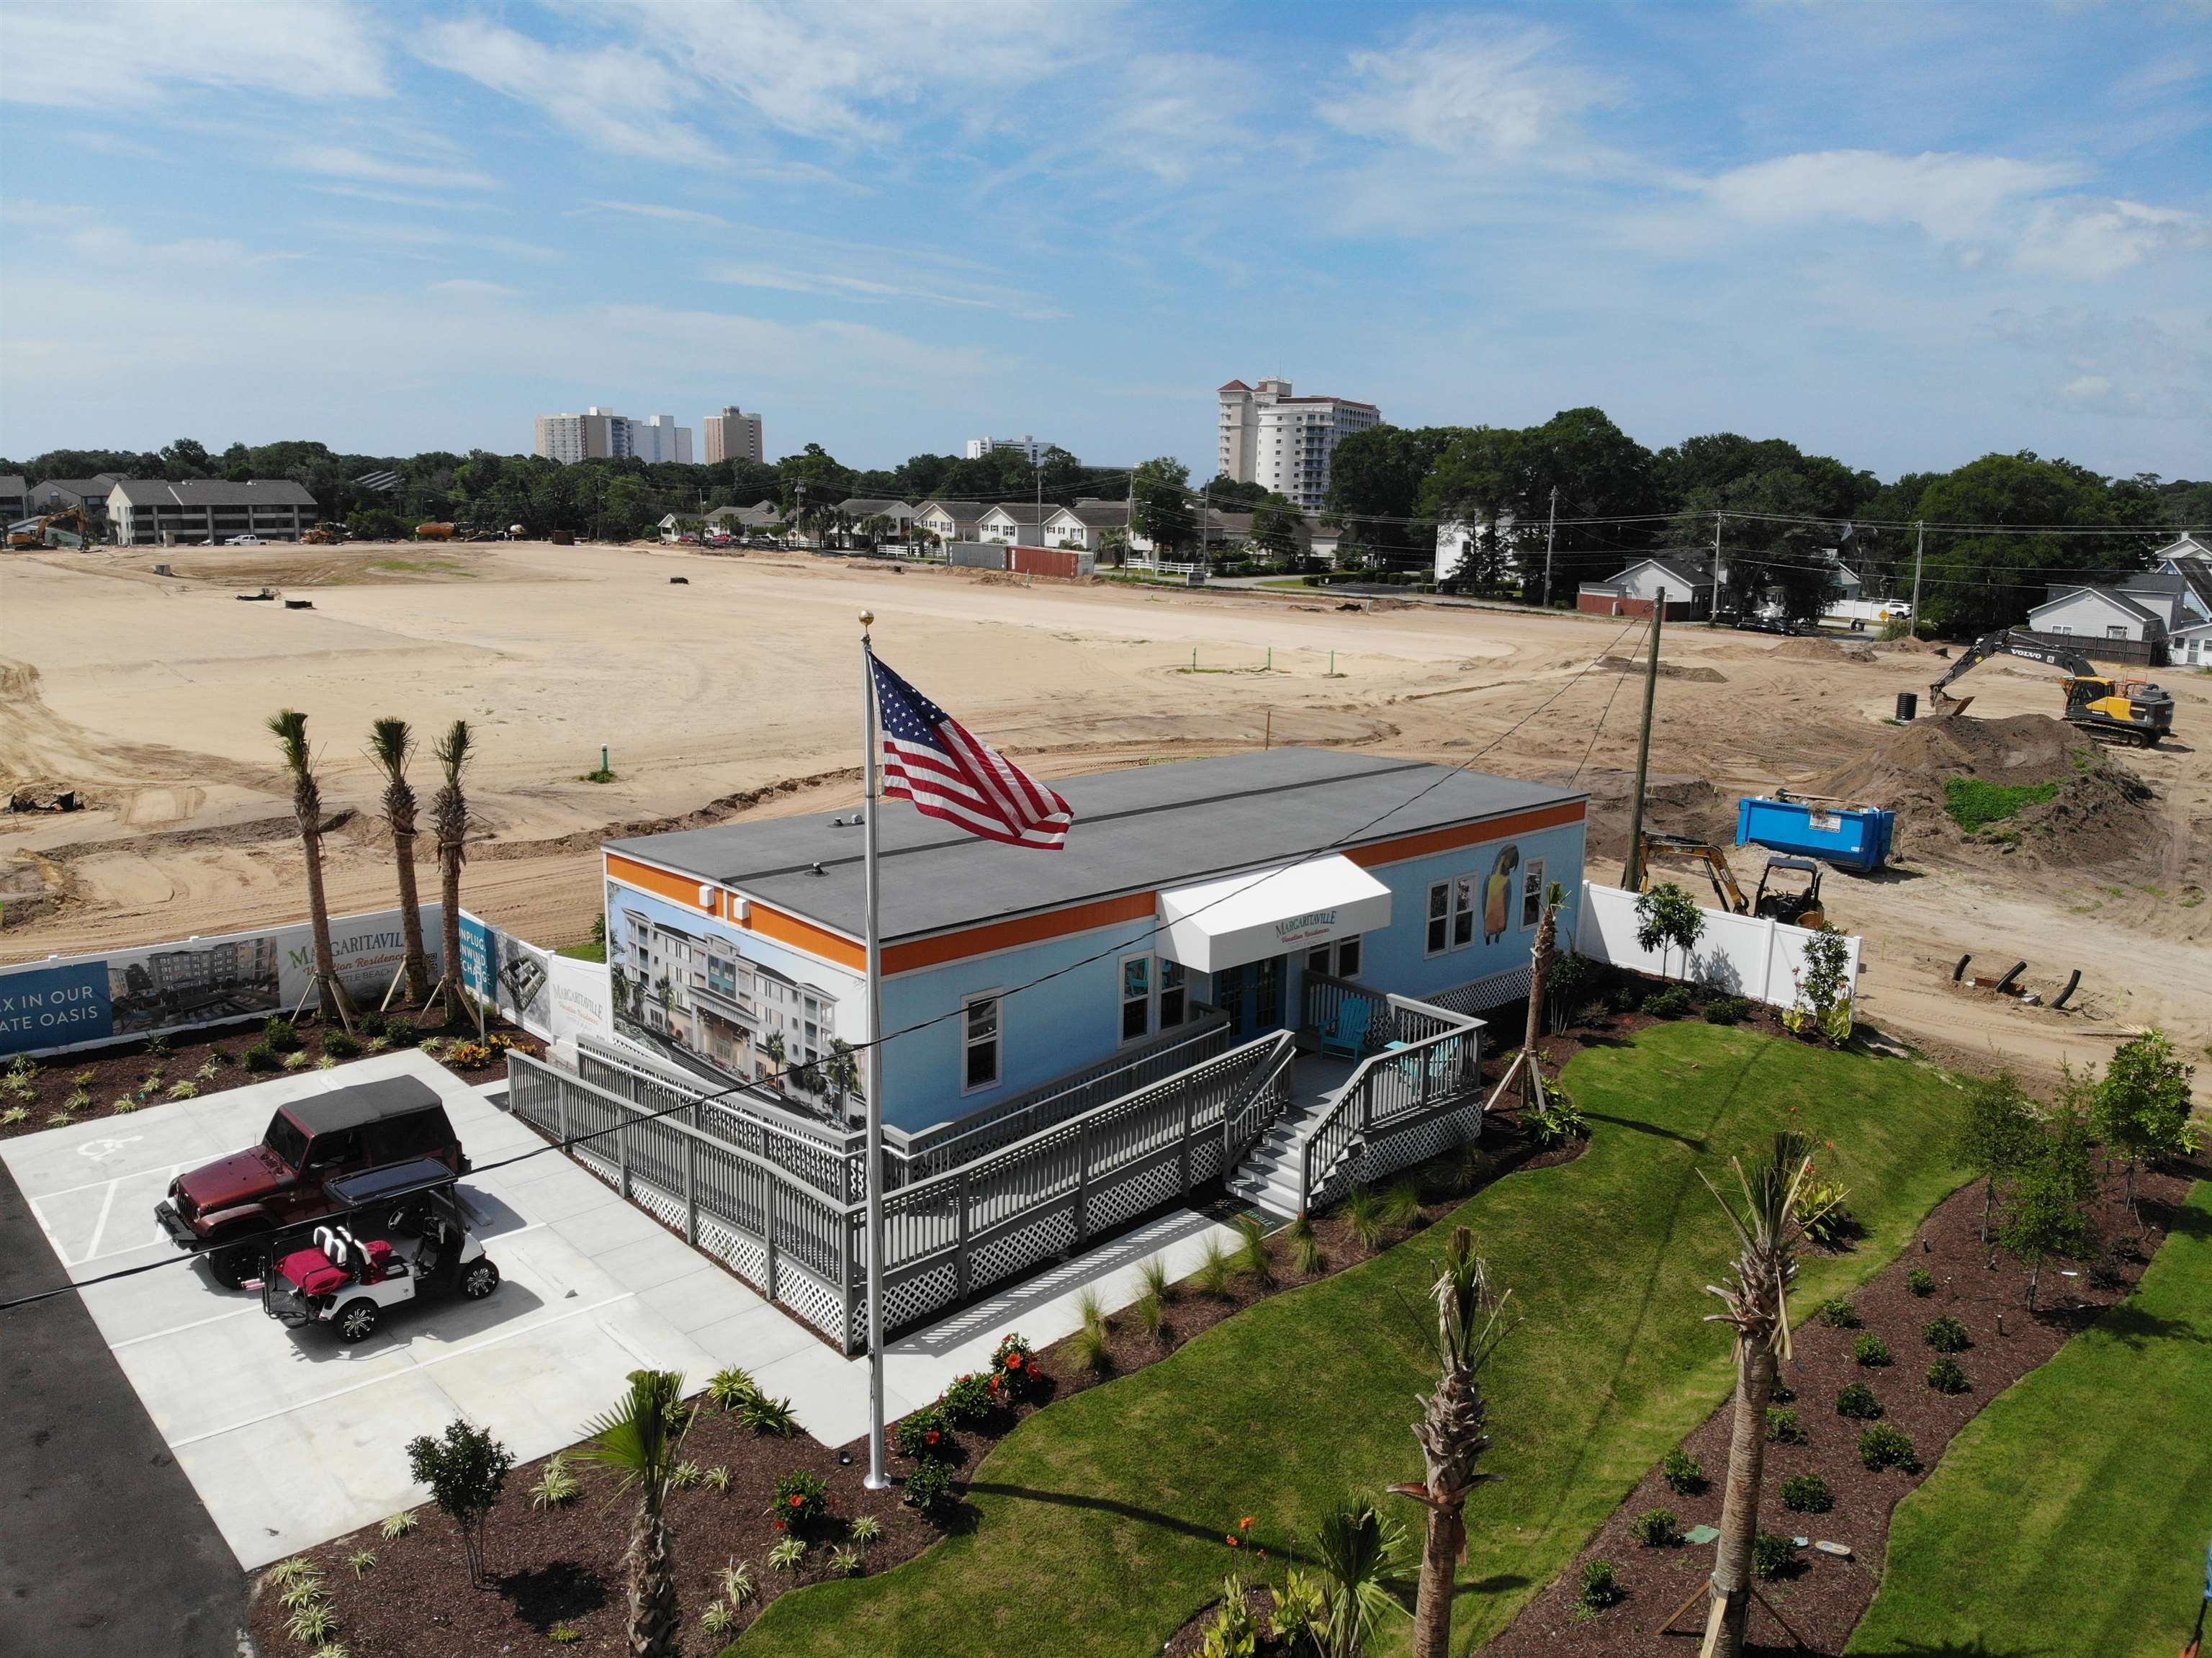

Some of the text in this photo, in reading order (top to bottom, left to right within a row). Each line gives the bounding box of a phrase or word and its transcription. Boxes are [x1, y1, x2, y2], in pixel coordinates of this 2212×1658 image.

[2010, 648, 2042, 659] VOLVO
[1275, 910, 1336, 938] MARGARITAVILLE
[363, 967, 393, 980] BEACH
[0, 986, 93, 1012] X IN OUR
[40, 1005, 98, 1026] OASIS
